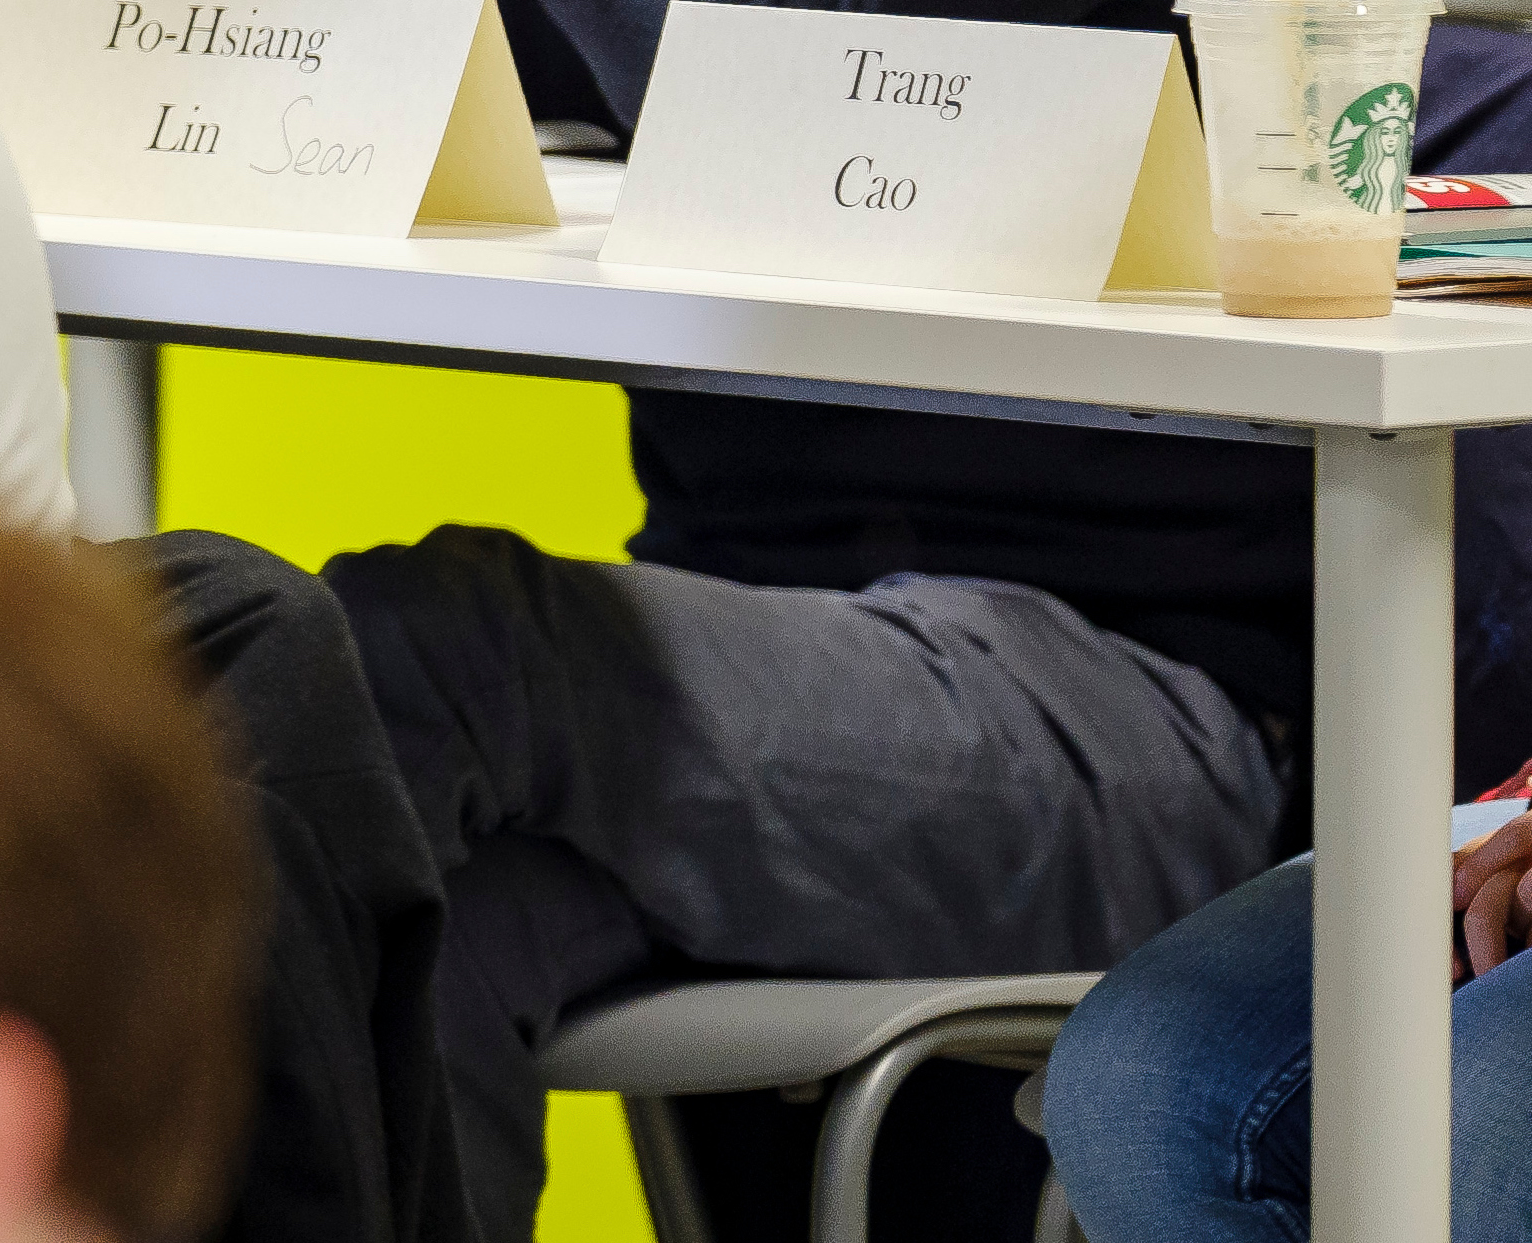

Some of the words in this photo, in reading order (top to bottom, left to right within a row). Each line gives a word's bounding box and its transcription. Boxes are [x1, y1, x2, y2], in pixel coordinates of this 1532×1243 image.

[103, 1, 332, 74] Po-Hsiang
[844, 48, 972, 121] Trang
[144, 103, 221, 155] Lin
[249, 95, 375, 176] Sean
[834, 154, 918, 212] Cao
